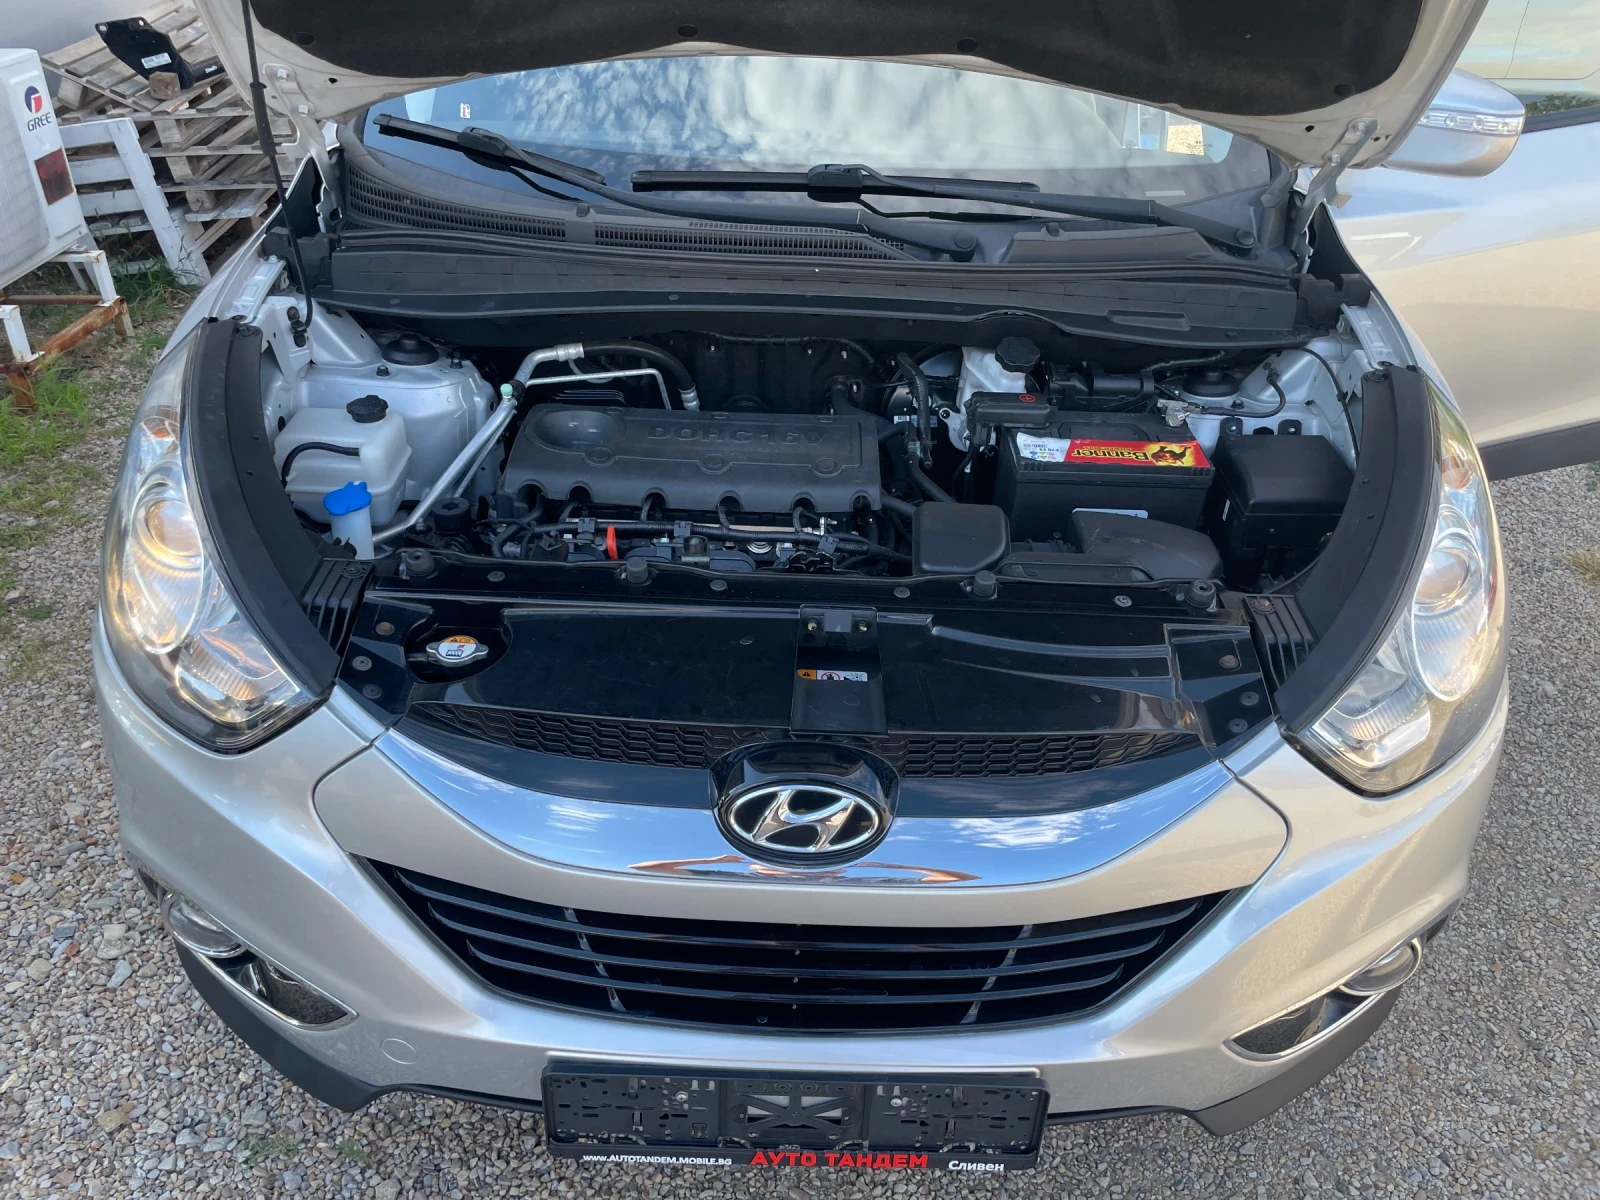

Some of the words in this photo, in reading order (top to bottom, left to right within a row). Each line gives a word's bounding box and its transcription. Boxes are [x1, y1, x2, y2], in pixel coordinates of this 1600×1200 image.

[27, 112, 52, 131] GREE
[648, 425, 752, 443] DOHC
[1071, 449, 1149, 461] Banner
[751, 1151, 816, 1166] АУТО
[825, 1152, 928, 1168] ТАНДЕМ
[948, 1160, 1004, 1171] Сливен
